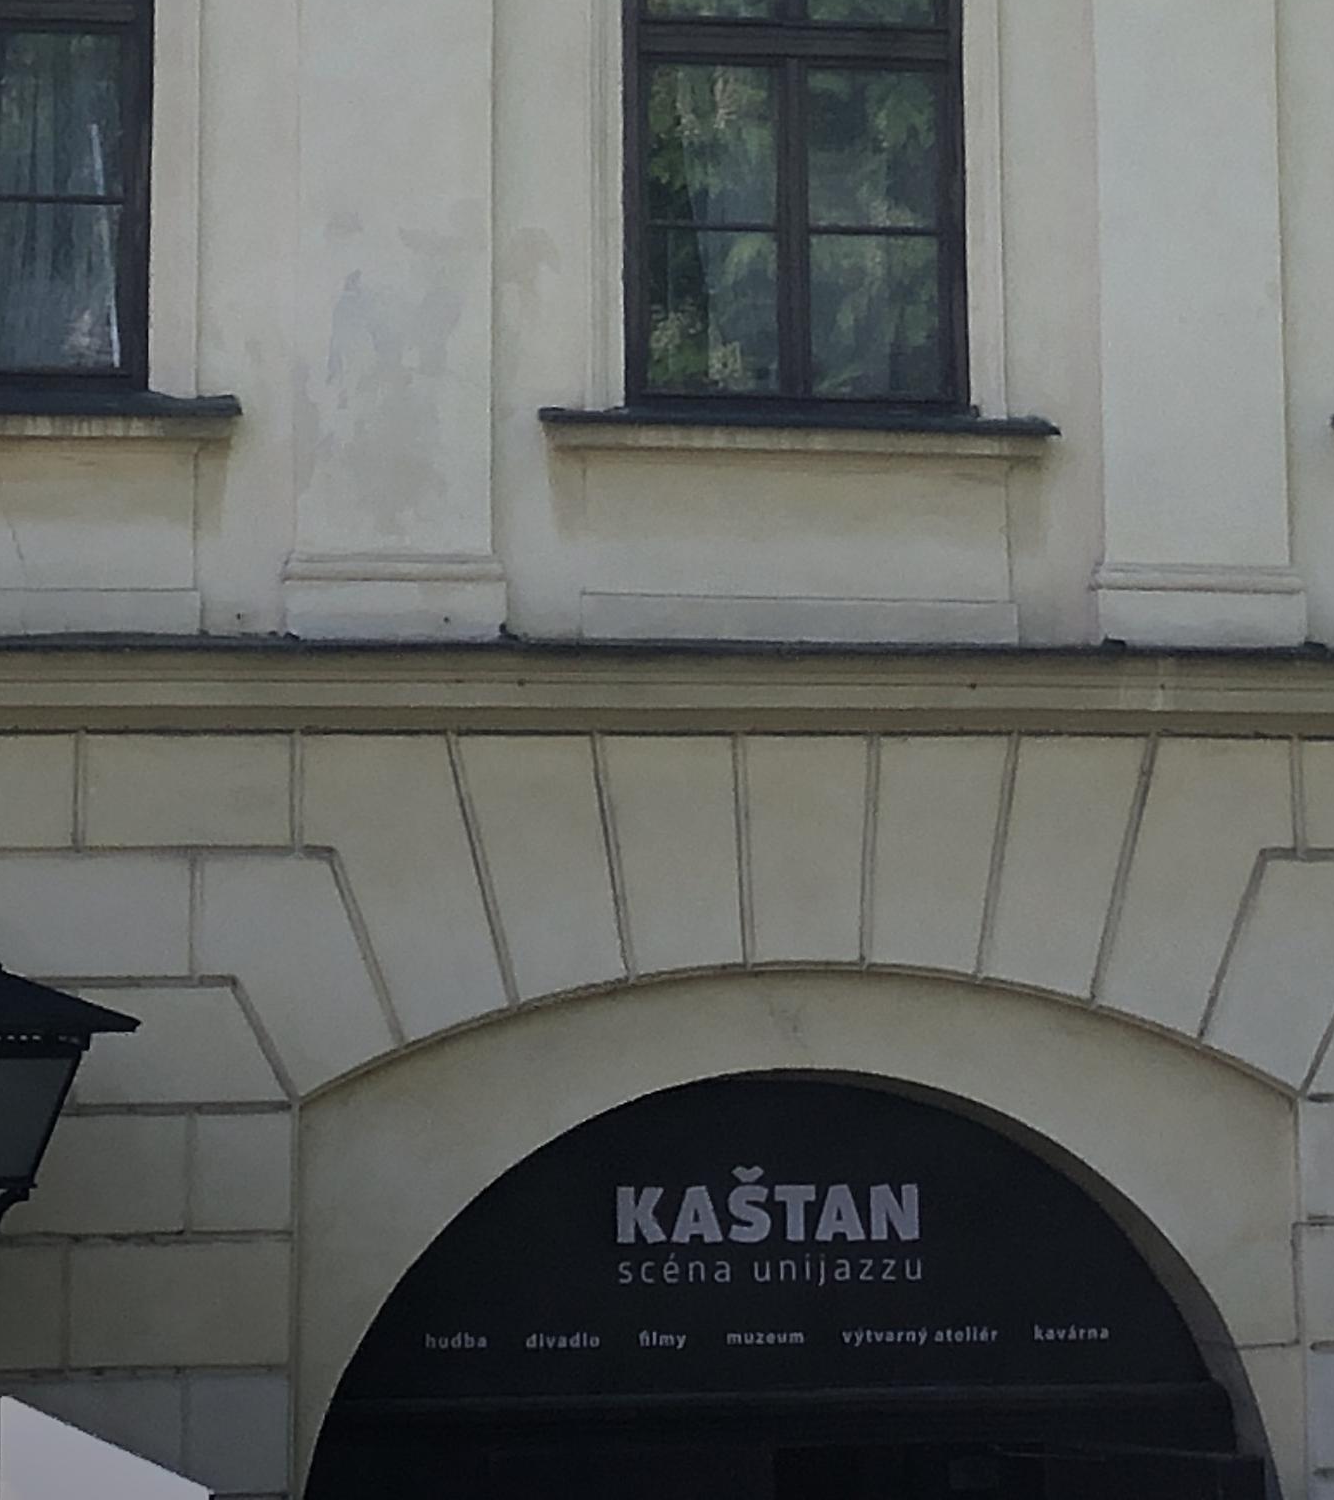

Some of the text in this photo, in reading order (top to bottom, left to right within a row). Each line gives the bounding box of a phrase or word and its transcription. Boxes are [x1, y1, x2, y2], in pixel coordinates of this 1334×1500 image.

[616, 1165, 920, 1244] KAŠTAN
[618, 1253, 923, 1286] scéna unijazzu
[424, 1323, 1110, 1349] hudba divadlo filmy muzeum výtvarný ateliér kavárna
